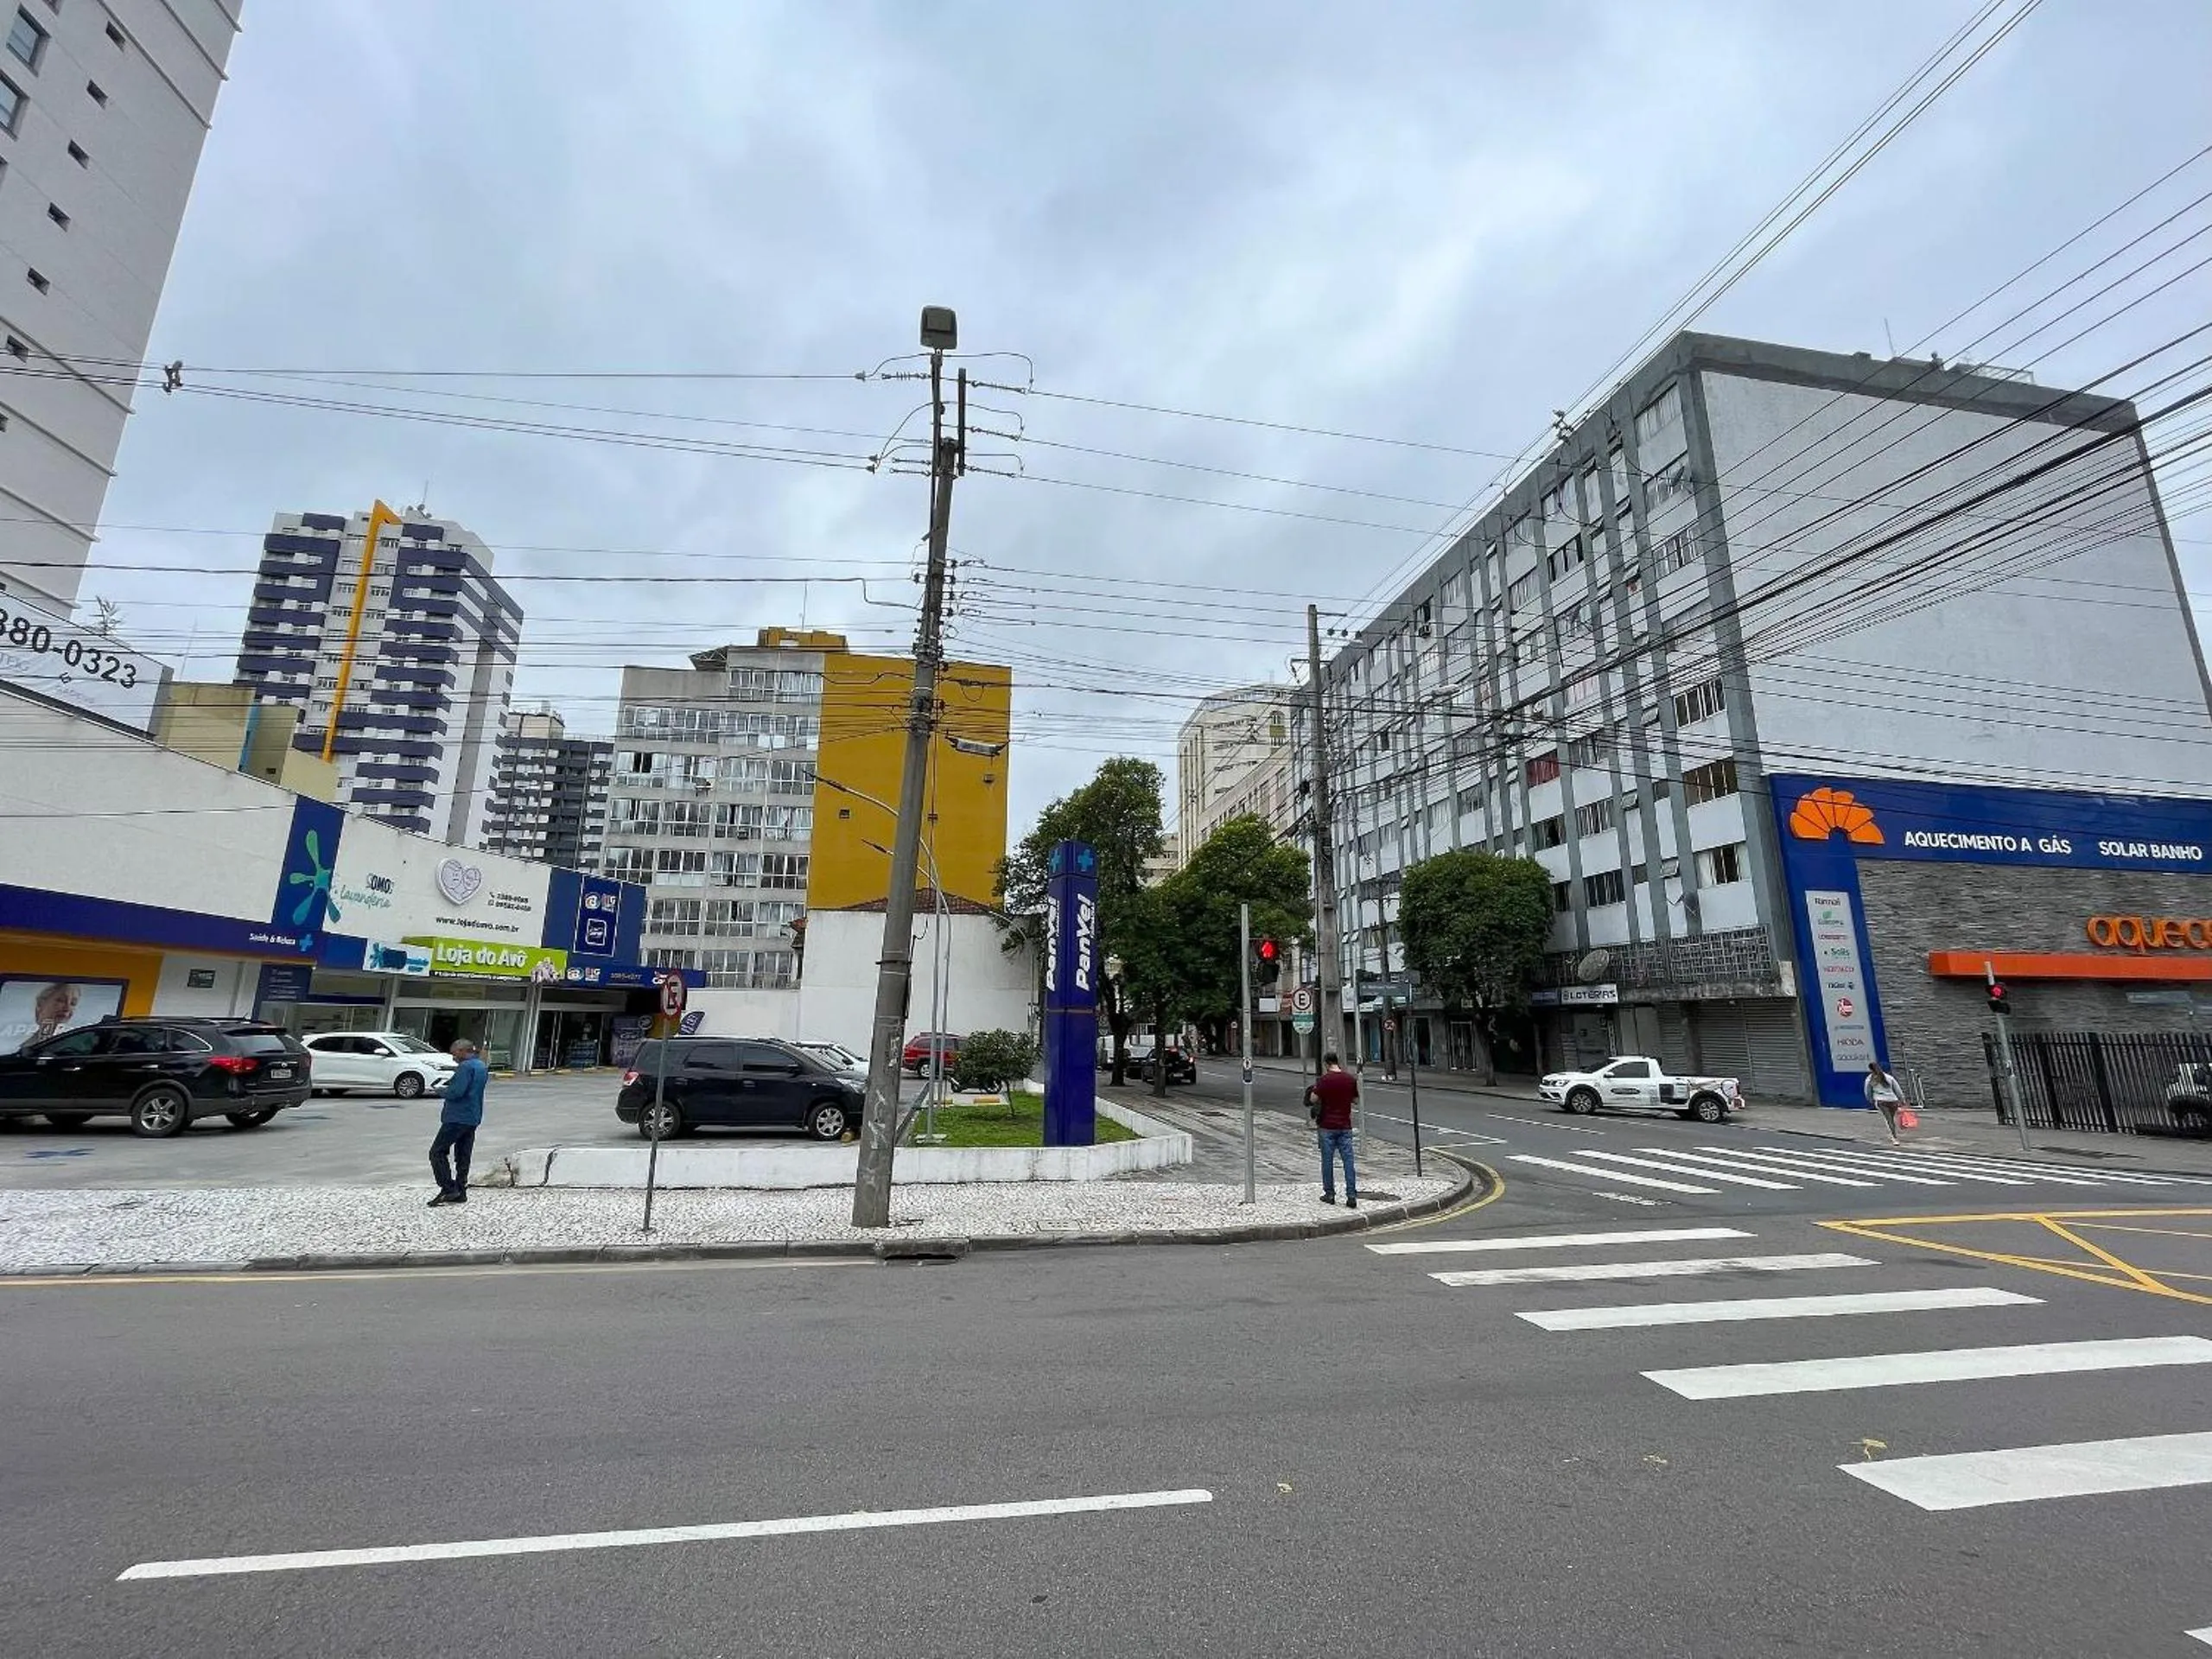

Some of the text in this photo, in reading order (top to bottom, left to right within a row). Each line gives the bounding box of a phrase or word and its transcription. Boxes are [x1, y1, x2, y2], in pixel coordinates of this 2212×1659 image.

[1904, 830, 2072, 855] AQUECIMENTO A GÁS
[2099, 841, 2203, 861] SOLAR BANHO
[436, 943, 473, 967] Loja
[476, 947, 497, 965] do
[498, 950, 527, 969] Avô
[1299, 993, 1306, 1006] E
